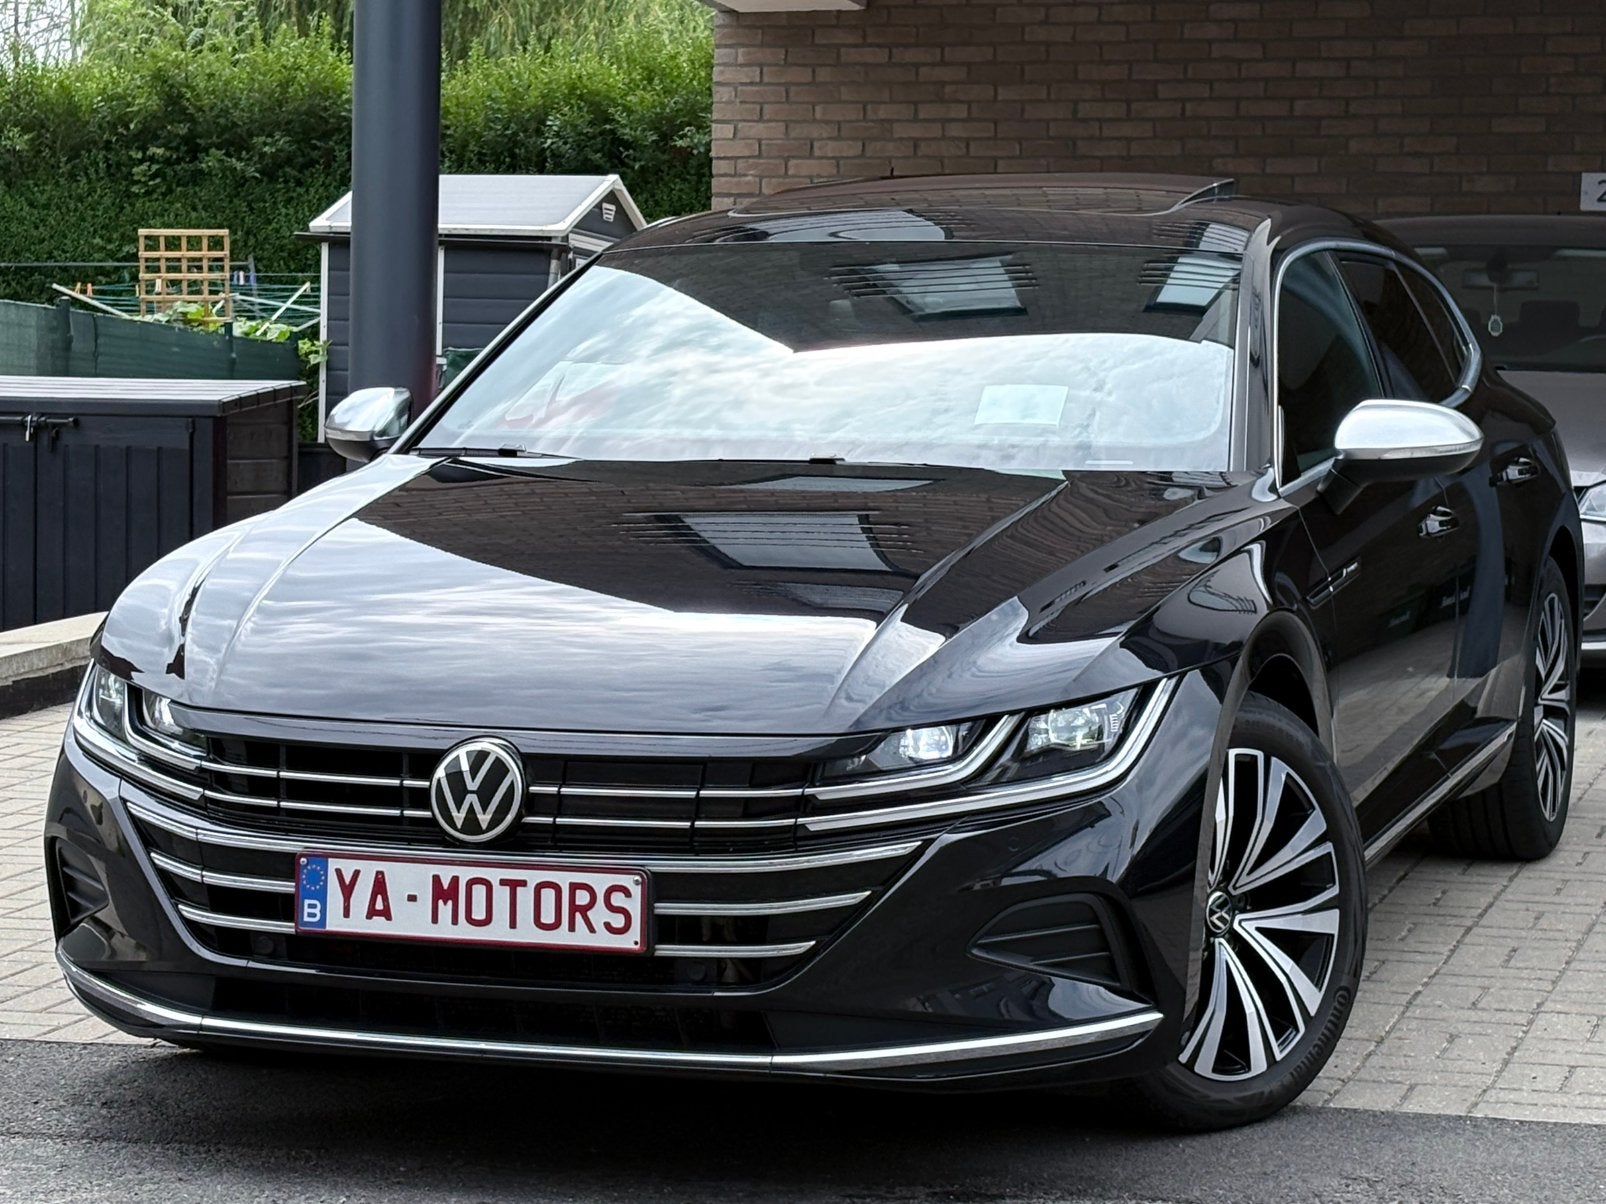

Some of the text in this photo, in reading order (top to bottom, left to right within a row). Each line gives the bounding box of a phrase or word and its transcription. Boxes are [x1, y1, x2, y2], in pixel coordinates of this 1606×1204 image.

[303, 899, 321, 923] B
[334, 867, 393, 922] YA
[431, 873, 633, 935] MOTORS
